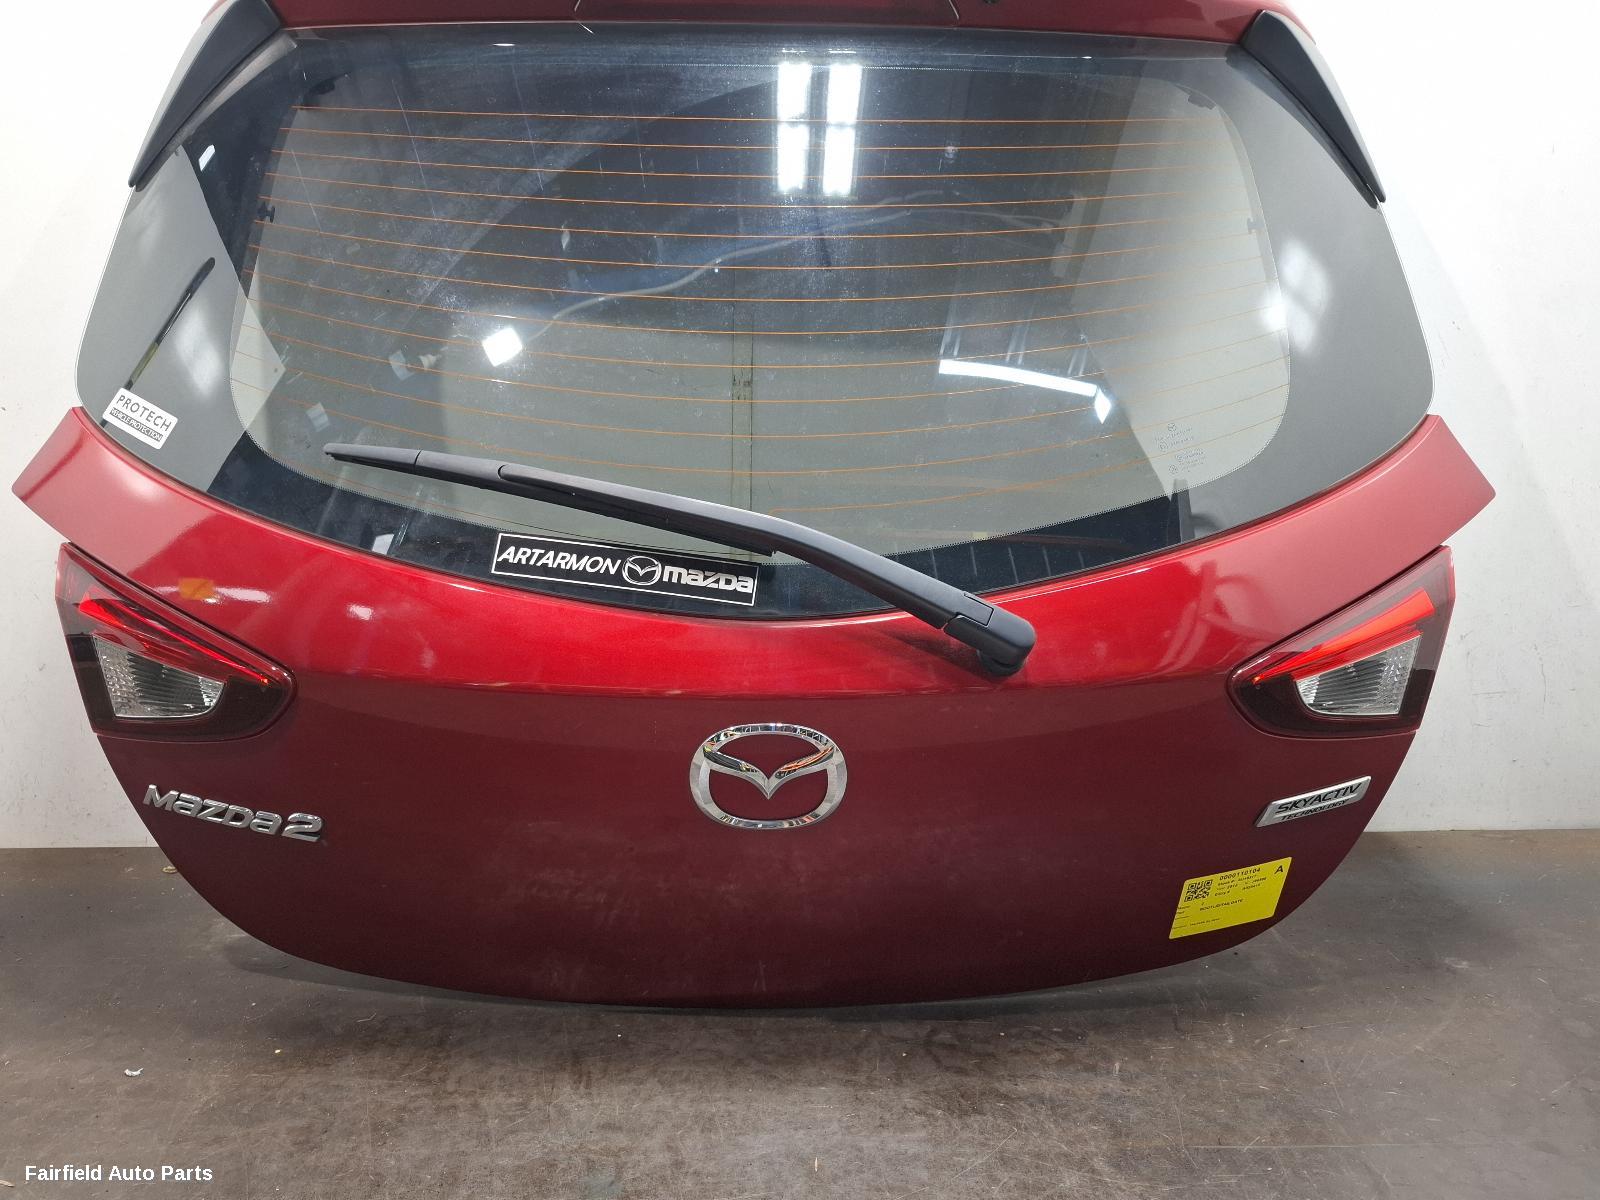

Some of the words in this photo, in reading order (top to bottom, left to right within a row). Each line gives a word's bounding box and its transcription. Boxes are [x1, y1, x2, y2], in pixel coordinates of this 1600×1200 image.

[116, 394, 172, 432] PROTECH
[497, 546, 622, 575] ARTARMON
[1276, 783, 1362, 814] SKYACTIV
[1281, 799, 1349, 821] TECHNOLOGY
[1274, 865, 1284, 875] A
